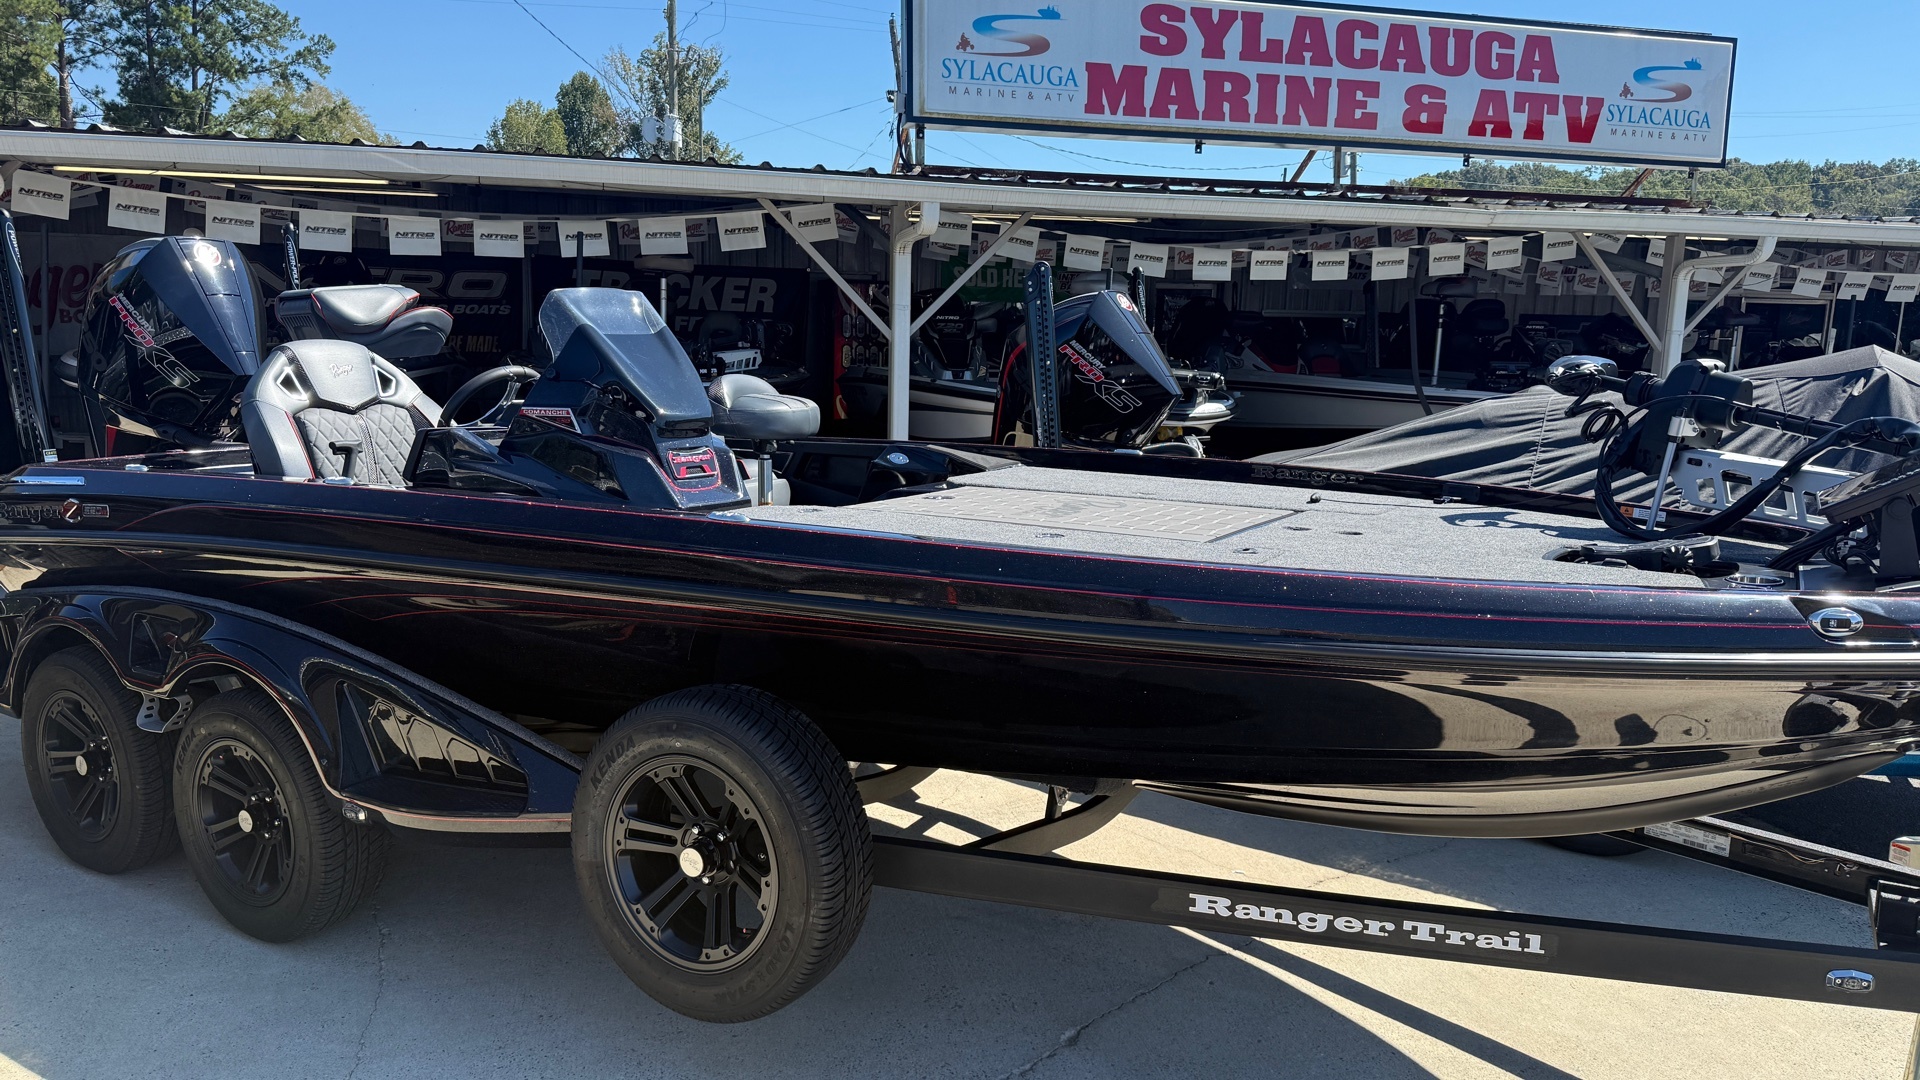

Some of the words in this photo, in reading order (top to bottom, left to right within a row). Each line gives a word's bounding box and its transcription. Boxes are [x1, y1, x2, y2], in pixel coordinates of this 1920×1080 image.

[1139, 3, 1560, 84] SYLACAUGA
[941, 57, 1079, 88] SYLACAUGA
[948, 85, 1018, 100] MARINE
[1027, 91, 1035, 100] &
[1044, 91, 1075, 103] ATV
[1084, 61, 1380, 130] MARINE
[1401, 83, 1448, 135] &
[1467, 88, 1605, 143] ATV
[1606, 102, 1711, 129] SYLACAUGA
[1610, 129, 1665, 140] MARINE
[1670, 131, 1677, 140] &
[1683, 132, 1708, 142] ATV
[18, 187, 64, 199] NITRO
[115, 203, 160, 215] NITRO
[212, 216, 254, 226] NITRO
[798, 217, 831, 228] NITRO
[305, 225, 346, 234] NITRO
[645, 231, 681, 239] NITRO
[724, 226, 758, 236] NITRO
[1547, 240, 1574, 248] NITRO
[1069, 246, 1099, 255] NITRO
[1492, 248, 1519, 257] NITRO
[1134, 253, 1163, 261] NITRO
[1198, 259, 1227, 267] NITRO
[1376, 259, 1404, 267] NITRO
[1433, 255, 1461, 263] NITRO
[1749, 271, 1771, 279] NITRO
[1800, 277, 1822, 285] NITRO
[117, 290, 155, 333] MERCURY
[452, 304, 512, 315] BOATS
[108, 295, 155, 347] PRO
[1069, 339, 1107, 369] MERCURY
[1058, 343, 1105, 383] PRO
[1250, 464, 1365, 487] Ranger
[176, 727, 197, 776] KENDA
[590, 735, 636, 791] KENDA
[1188, 892, 1396, 936] Ranger
[1403, 920, 1545, 954] Trail
